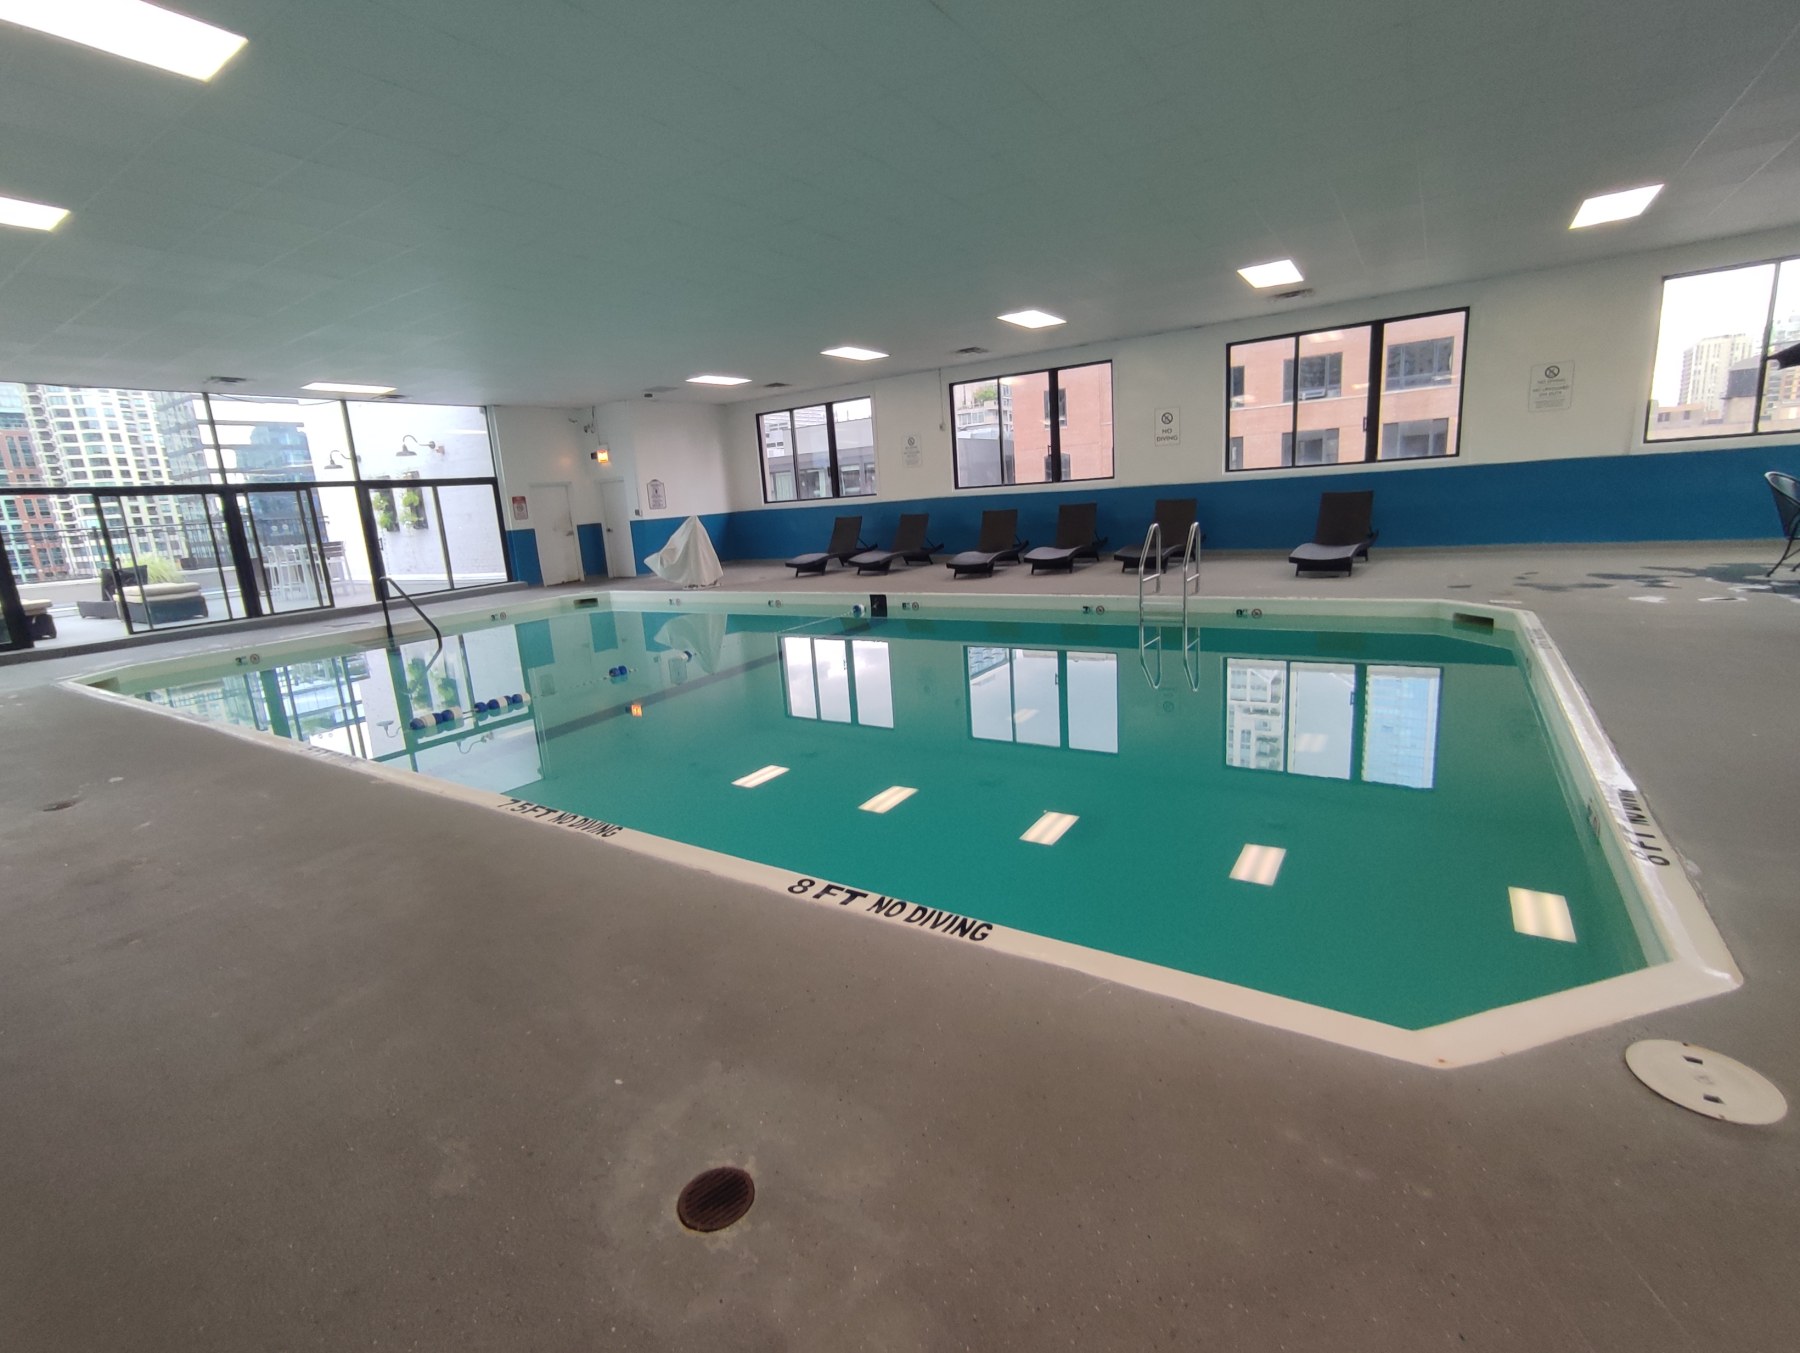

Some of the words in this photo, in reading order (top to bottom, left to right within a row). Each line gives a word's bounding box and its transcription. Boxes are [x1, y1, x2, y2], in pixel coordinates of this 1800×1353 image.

[547, 812, 578, 825] NO
[567, 817, 623, 838] DIVING
[787, 878, 816, 895] 8
[812, 884, 868, 906] FT
[866, 896, 907, 918] NO
[903, 905, 993, 942] DIVING
